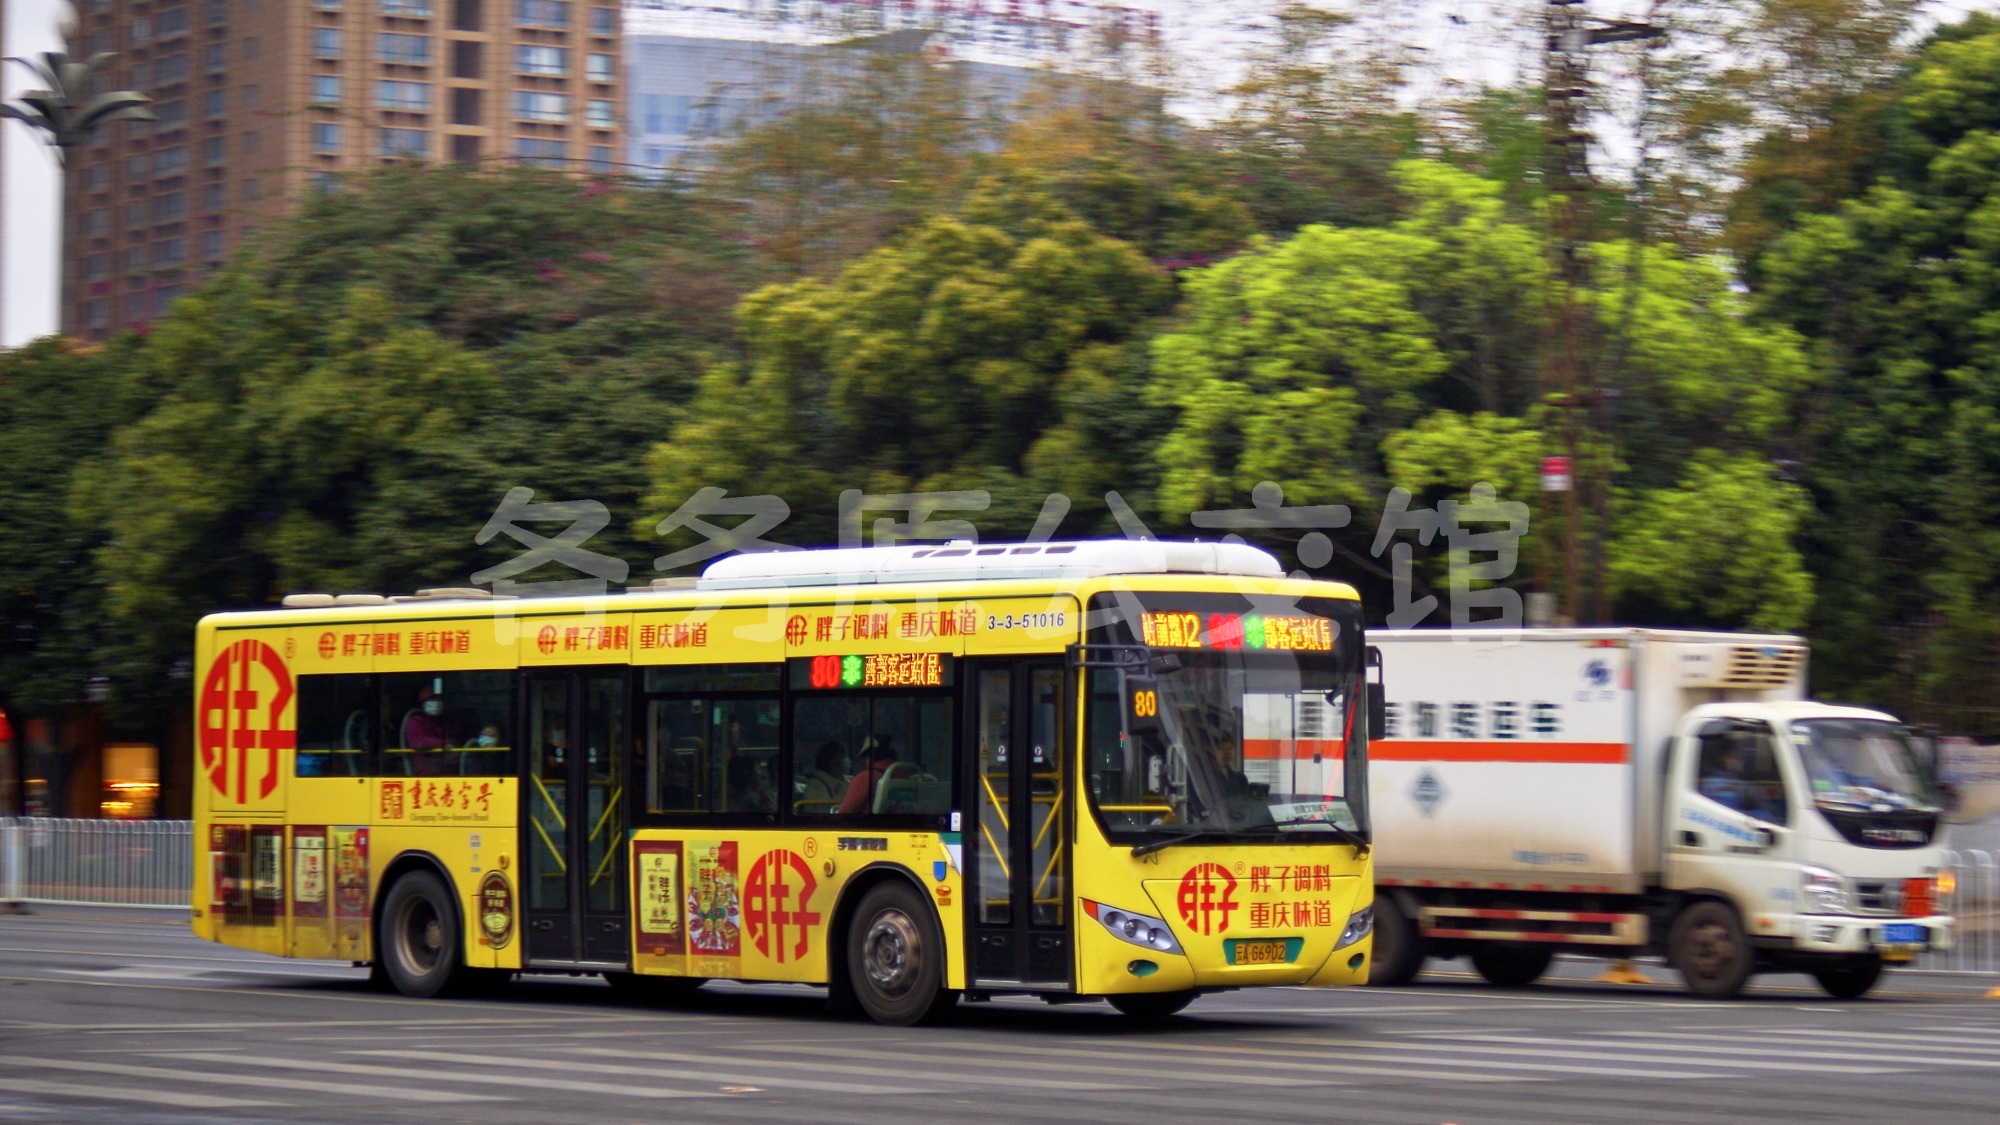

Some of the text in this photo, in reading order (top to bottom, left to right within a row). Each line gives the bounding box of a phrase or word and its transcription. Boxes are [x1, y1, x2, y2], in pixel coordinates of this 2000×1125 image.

[815, 612, 889, 642] 胖子调料
[900, 609, 977, 639] 重庆味道
[988, 612, 1065, 630] 3-3-51016
[564, 625, 629, 651] 胖子调料
[639, 622, 708, 649] 重庆味道
[811, 654, 841, 688] 80
[1134, 690, 1157, 717] 80
[407, 779, 494, 812] 重庆老字号
[1250, 864, 1332, 893] 胖子调料
[1250, 900, 1332, 929] 重庆味道
